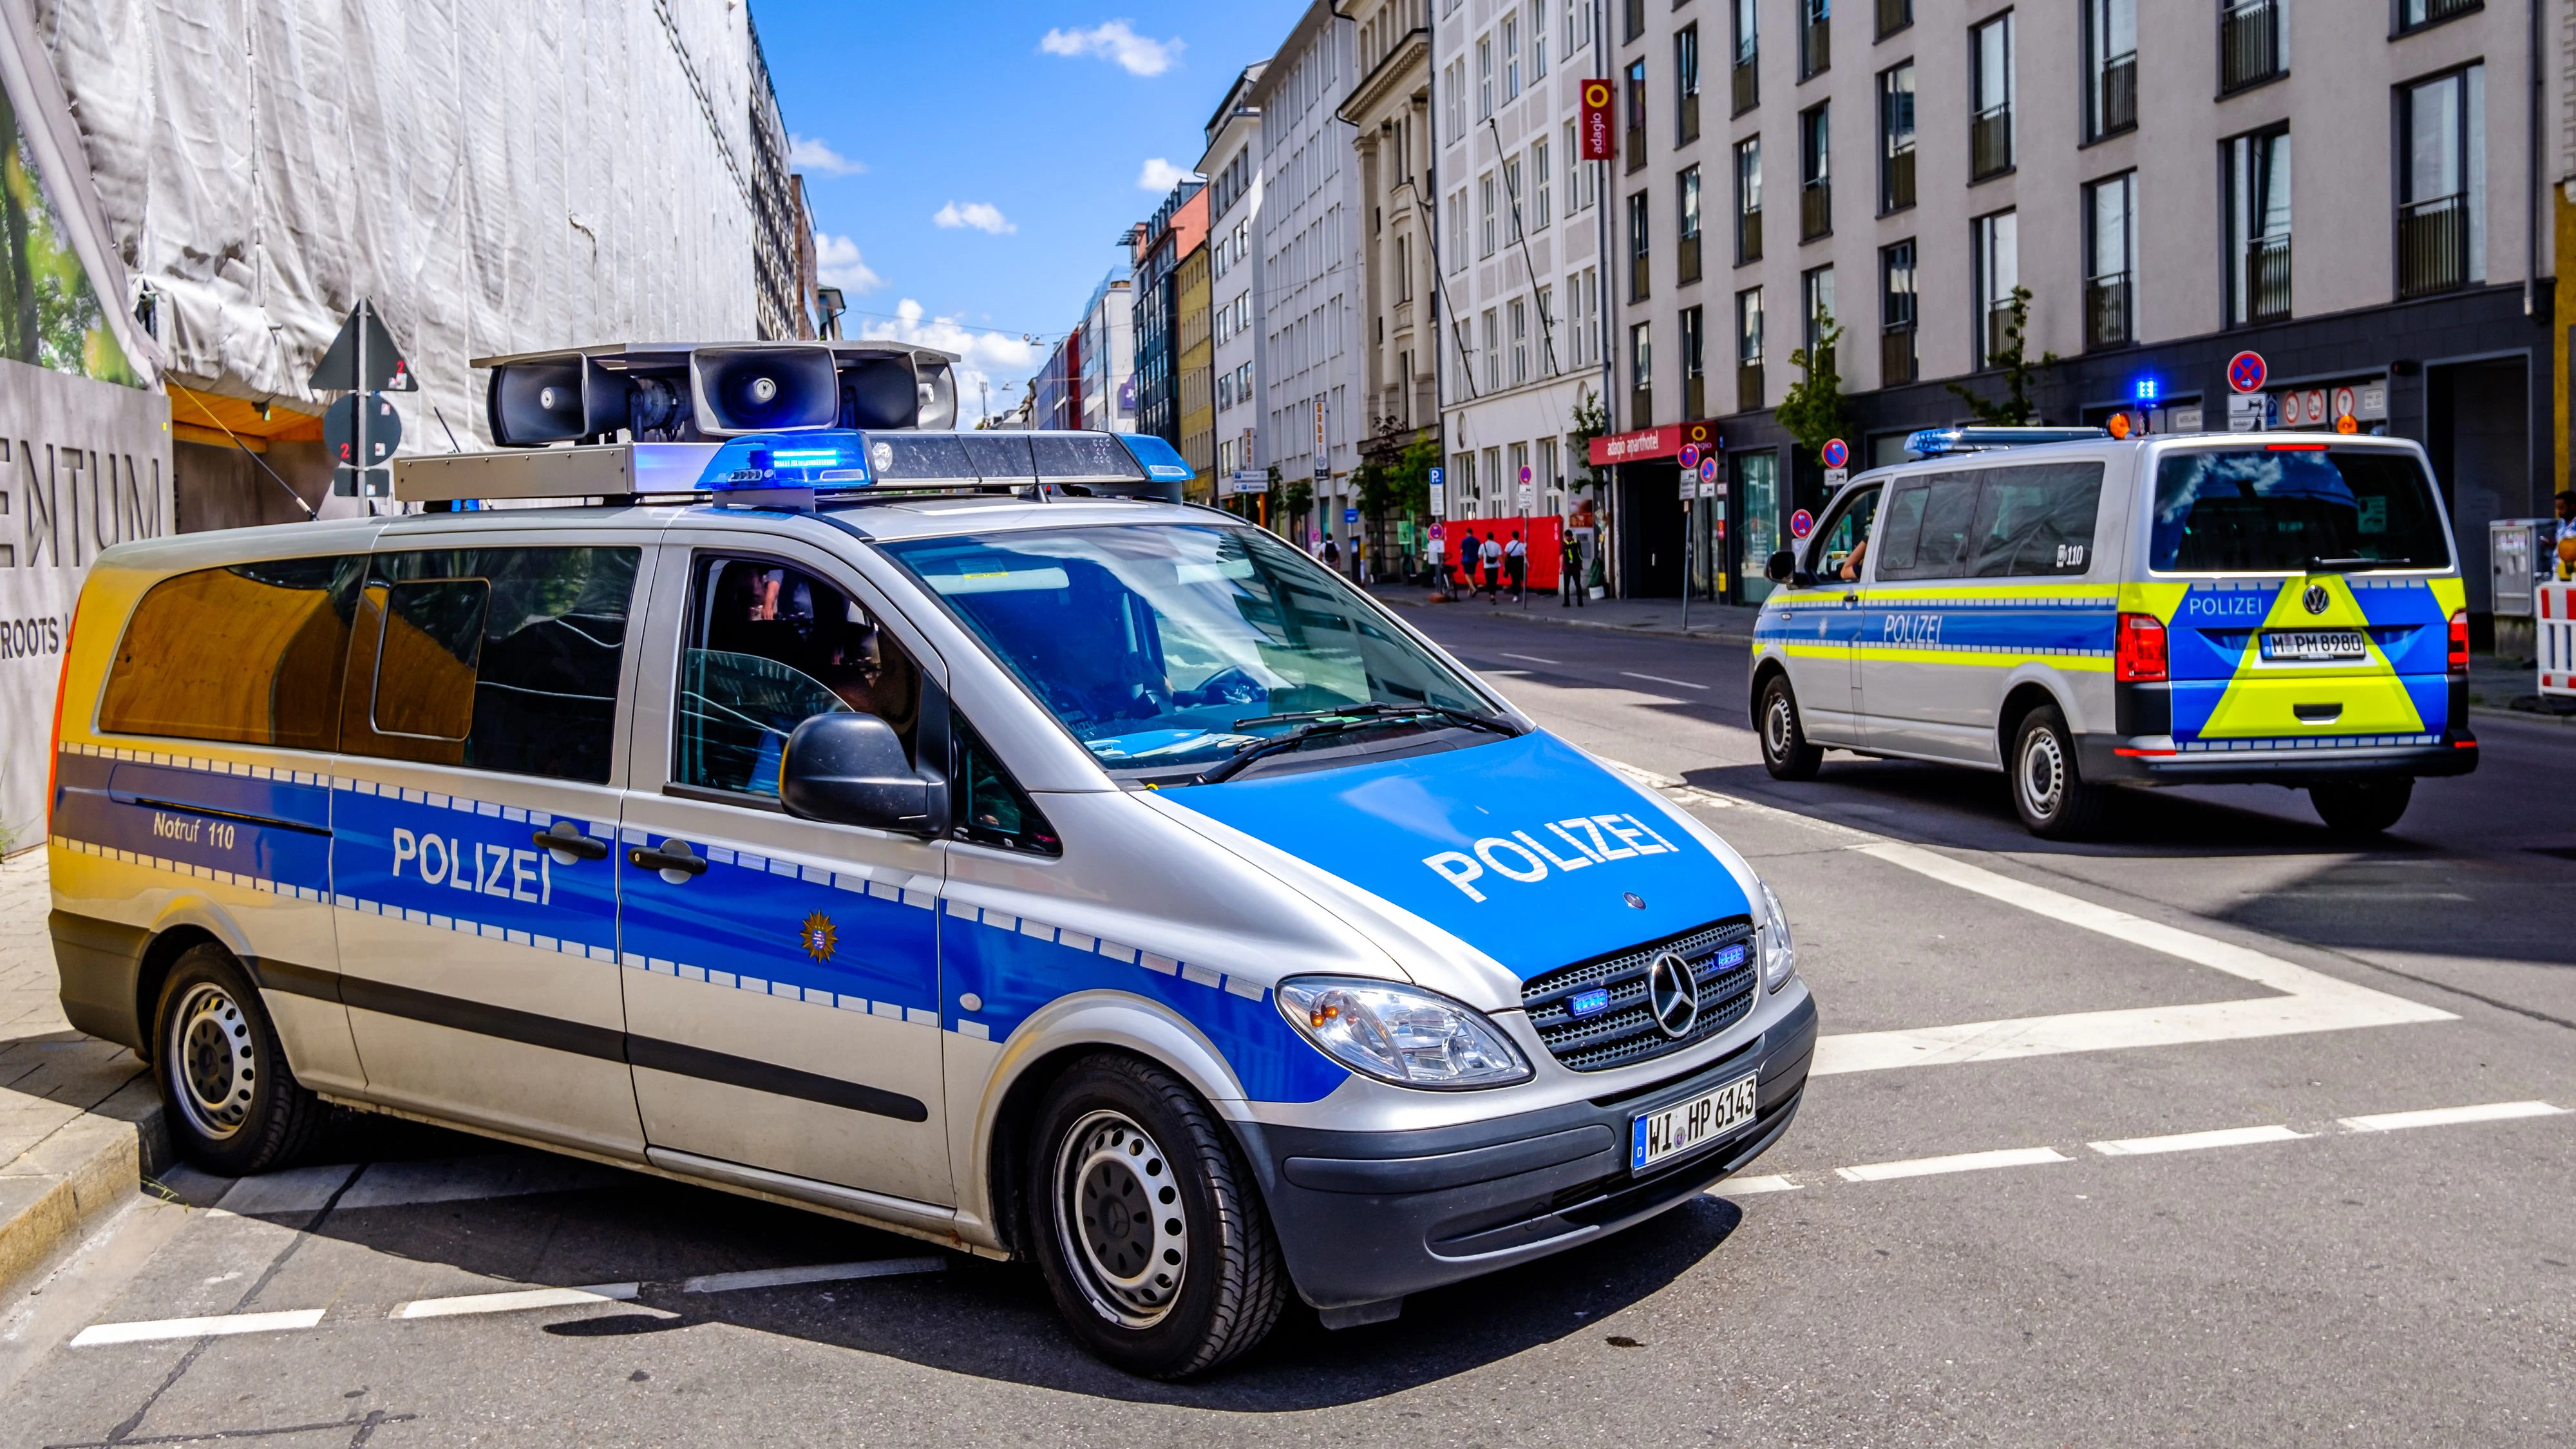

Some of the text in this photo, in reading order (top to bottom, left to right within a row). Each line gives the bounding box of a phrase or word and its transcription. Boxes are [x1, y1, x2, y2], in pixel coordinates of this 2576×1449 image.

[1590, 113, 1605, 153] adagio
[341, 443, 350, 459] 2
[1607, 430, 1658, 460] adagio aparthotel
[2067, 545, 2083, 565] 110
[2190, 597, 2262, 616] POLIZEI
[1, 617, 59, 659] ROOTS
[1884, 614, 1942, 643] POLIZEI
[2272, 634, 2361, 653] M PM 8980
[154, 812, 234, 849] Notruf 110
[392, 828, 551, 905] POLIZEI
[1422, 813, 1680, 902] POLIZEI
[1649, 1078, 1755, 1157] WI HP 6143
[1637, 1146, 1642, 1158] D
